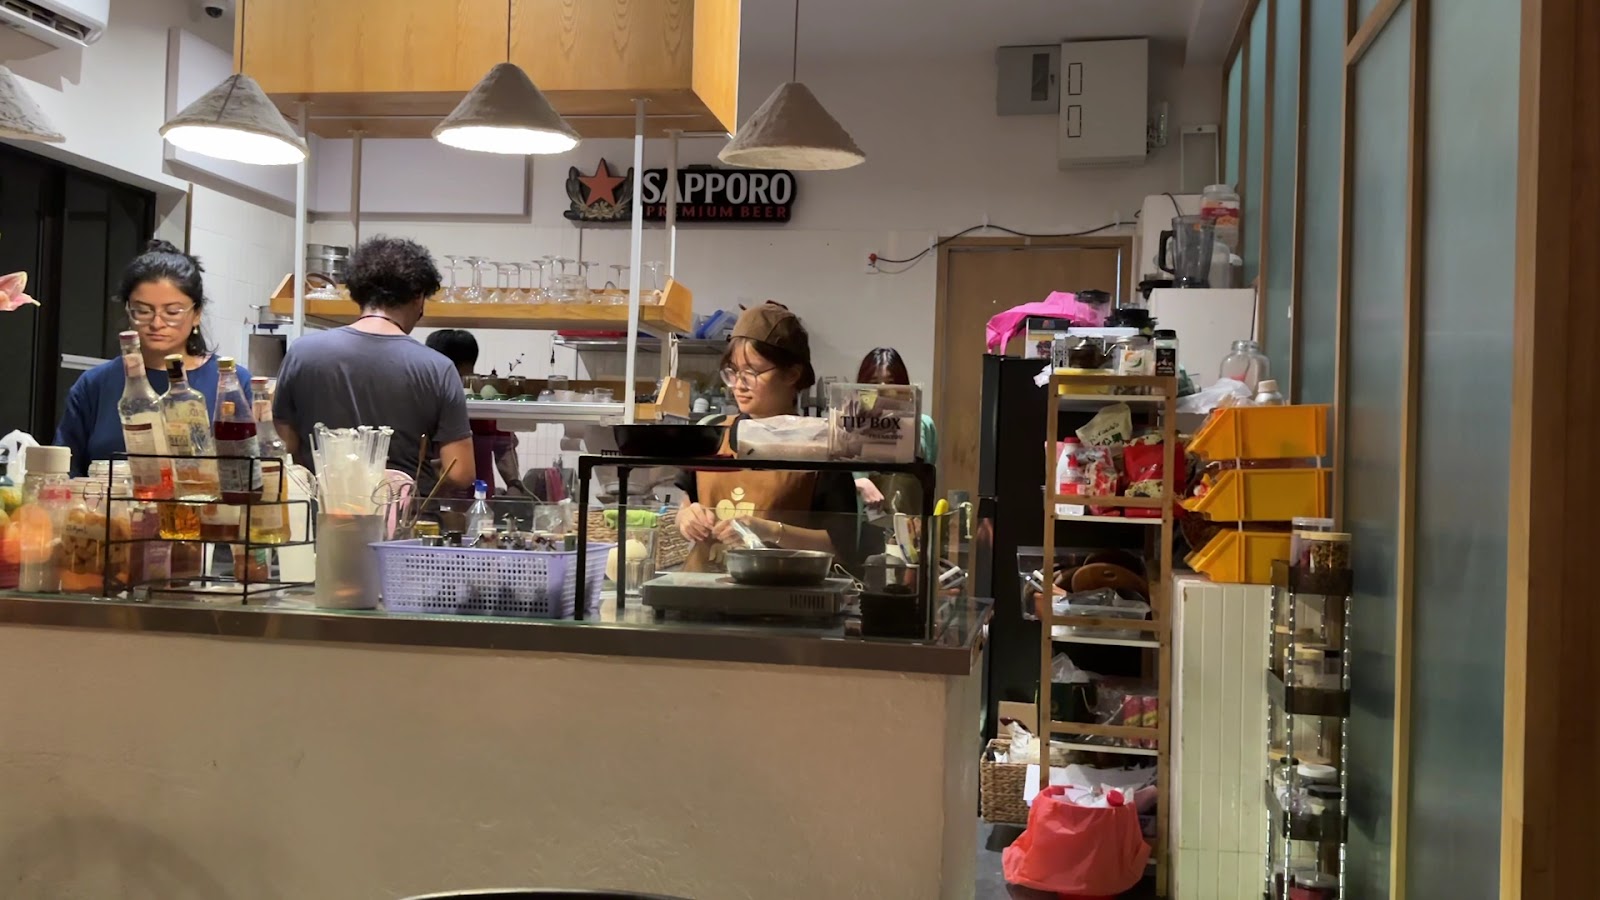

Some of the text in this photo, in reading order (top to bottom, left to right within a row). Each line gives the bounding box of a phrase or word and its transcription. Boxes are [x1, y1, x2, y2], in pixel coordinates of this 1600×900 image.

[646, 205, 786, 217] PRMIUM BEER
[840, 416, 901, 430] TIP BOX
